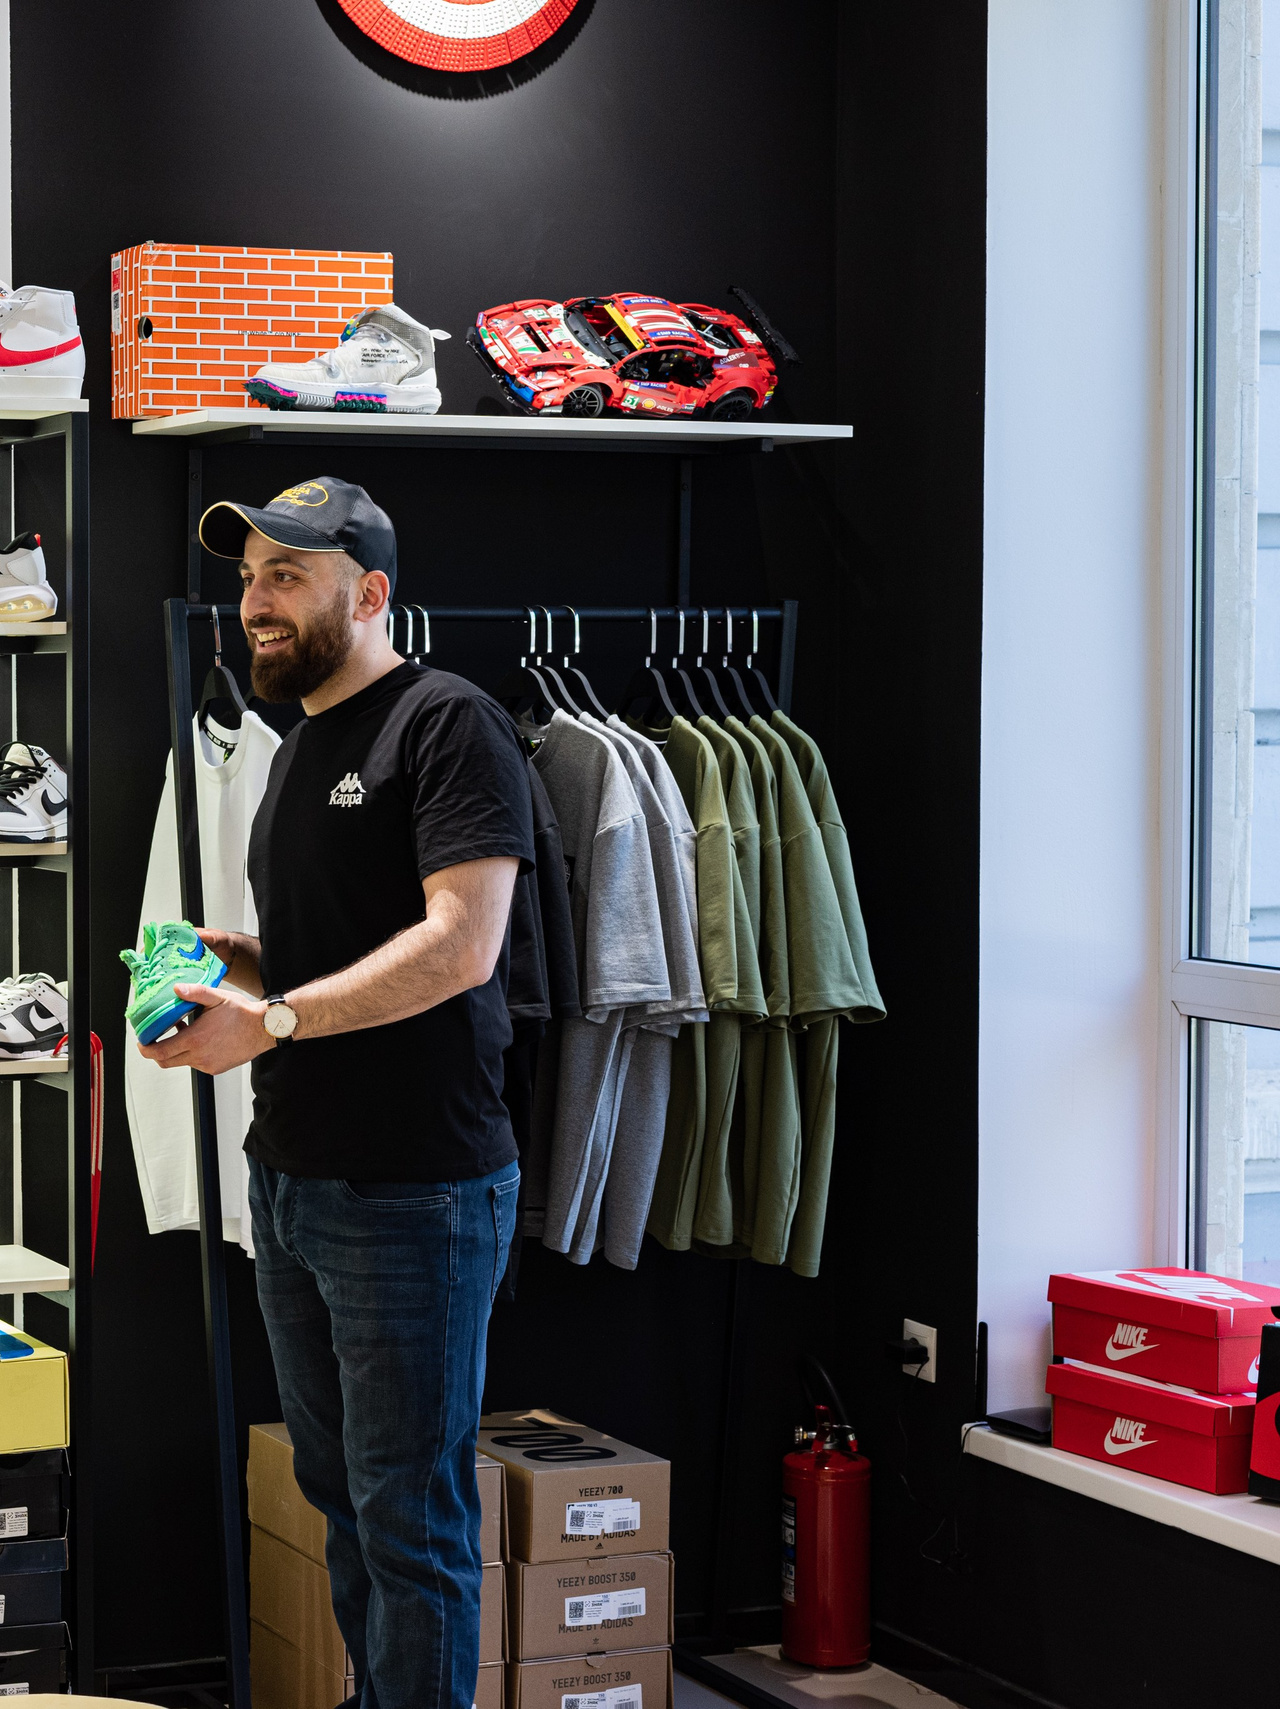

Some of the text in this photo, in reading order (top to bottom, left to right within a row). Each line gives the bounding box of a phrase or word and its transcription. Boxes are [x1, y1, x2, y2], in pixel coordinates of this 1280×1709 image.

[625, 395, 640, 406] 51
[328, 792, 363, 808] Kappa
[1112, 1322, 1149, 1348] NIKE
[1111, 1416, 1147, 1443] NIKE
[578, 1485, 624, 1498] YEEZY 700
[557, 1571, 636, 1588] YEEZY BOOST 350
[558, 1622, 584, 1634] MADE
[600, 1617, 634, 1629] ADIDAS
[552, 1671, 631, 1689] YEEZY BOOST 350
